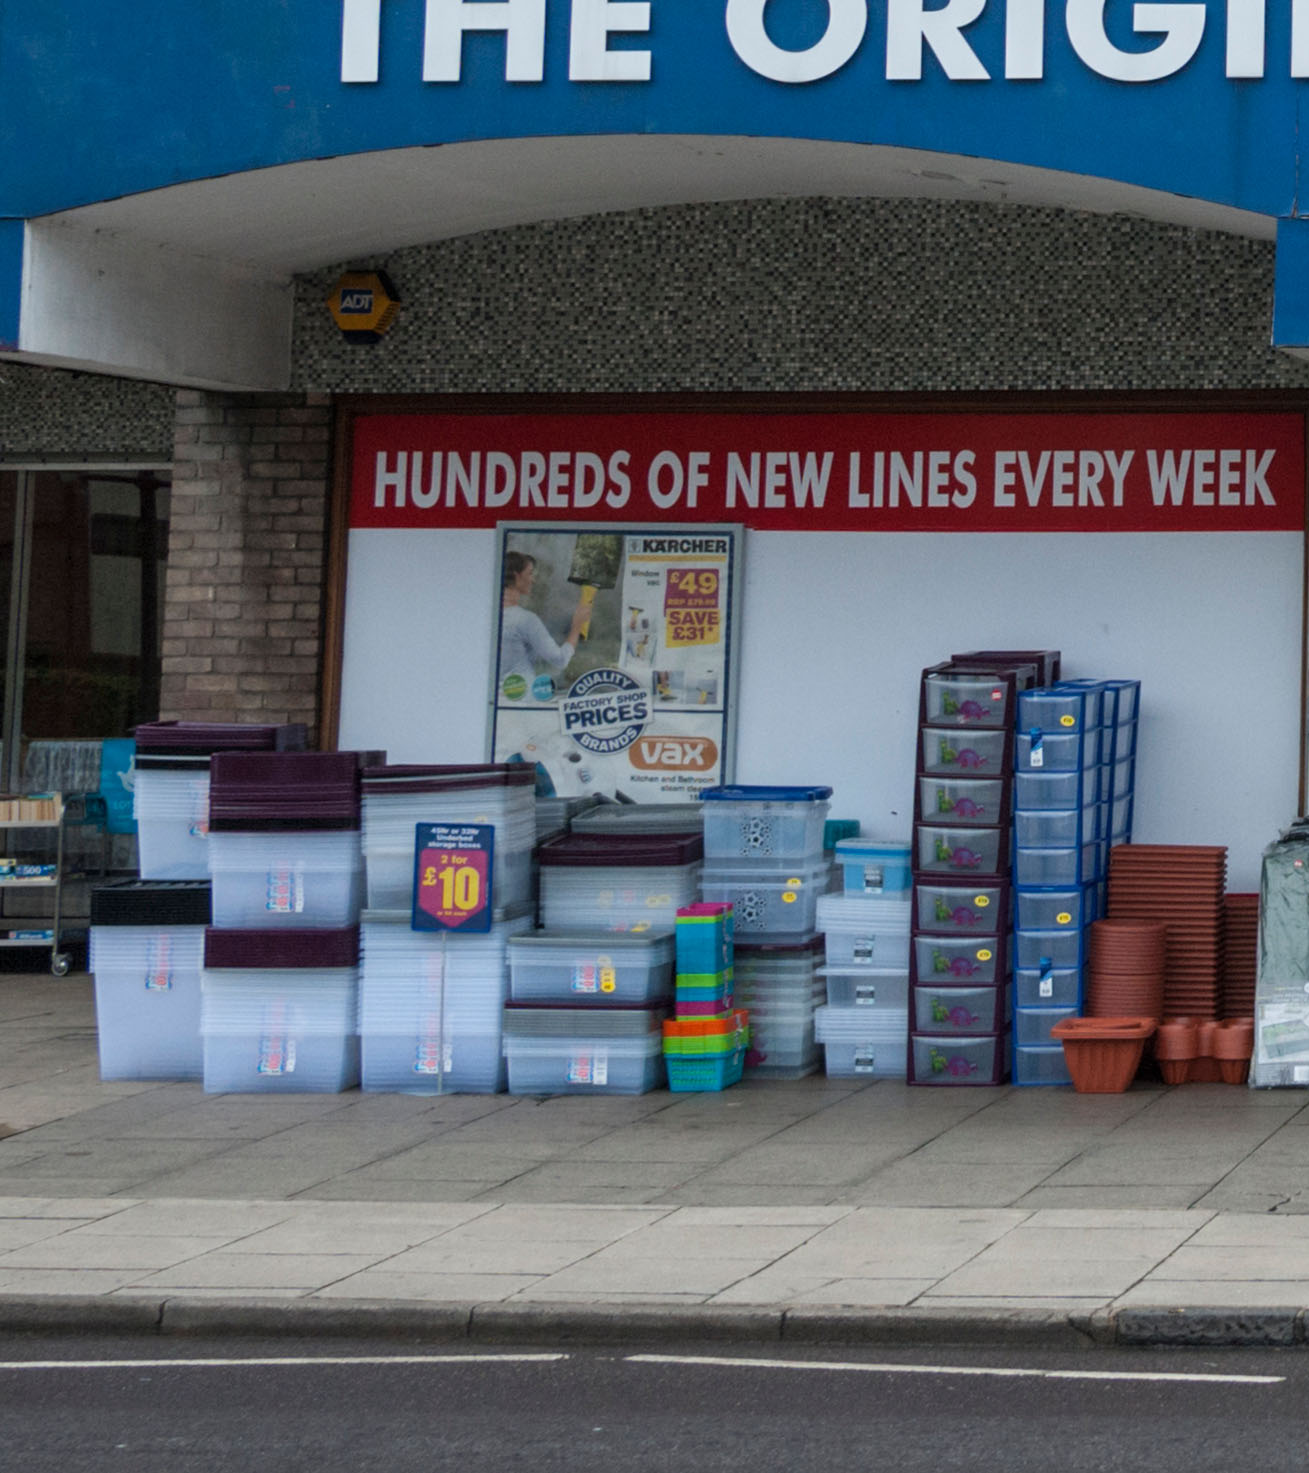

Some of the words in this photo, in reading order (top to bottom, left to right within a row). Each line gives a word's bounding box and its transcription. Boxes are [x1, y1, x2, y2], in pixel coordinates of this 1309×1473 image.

[341, 294, 373, 309] ADT
[374, 450, 632, 510] HUNDREDS
[647, 450, 711, 510] OF
[725, 450, 834, 509] NEW
[848, 449, 977, 509] LINES
[993, 449, 1135, 508] EVERY
[1146, 448, 1276, 507] WEEK
[670, 572, 717, 594] £49
[669, 611, 719, 625] SAVE
[575, 670, 632, 694] QUALITY
[563, 696, 613, 711] FACTORY
[617, 691, 647, 703] SHOP
[565, 702, 648, 730] PRICES
[580, 727, 638, 751] BRANDS
[640, 742, 704, 766] vax
[441, 854, 448, 864] 2
[452, 855, 468, 864] for
[422, 866, 480, 910] £10
